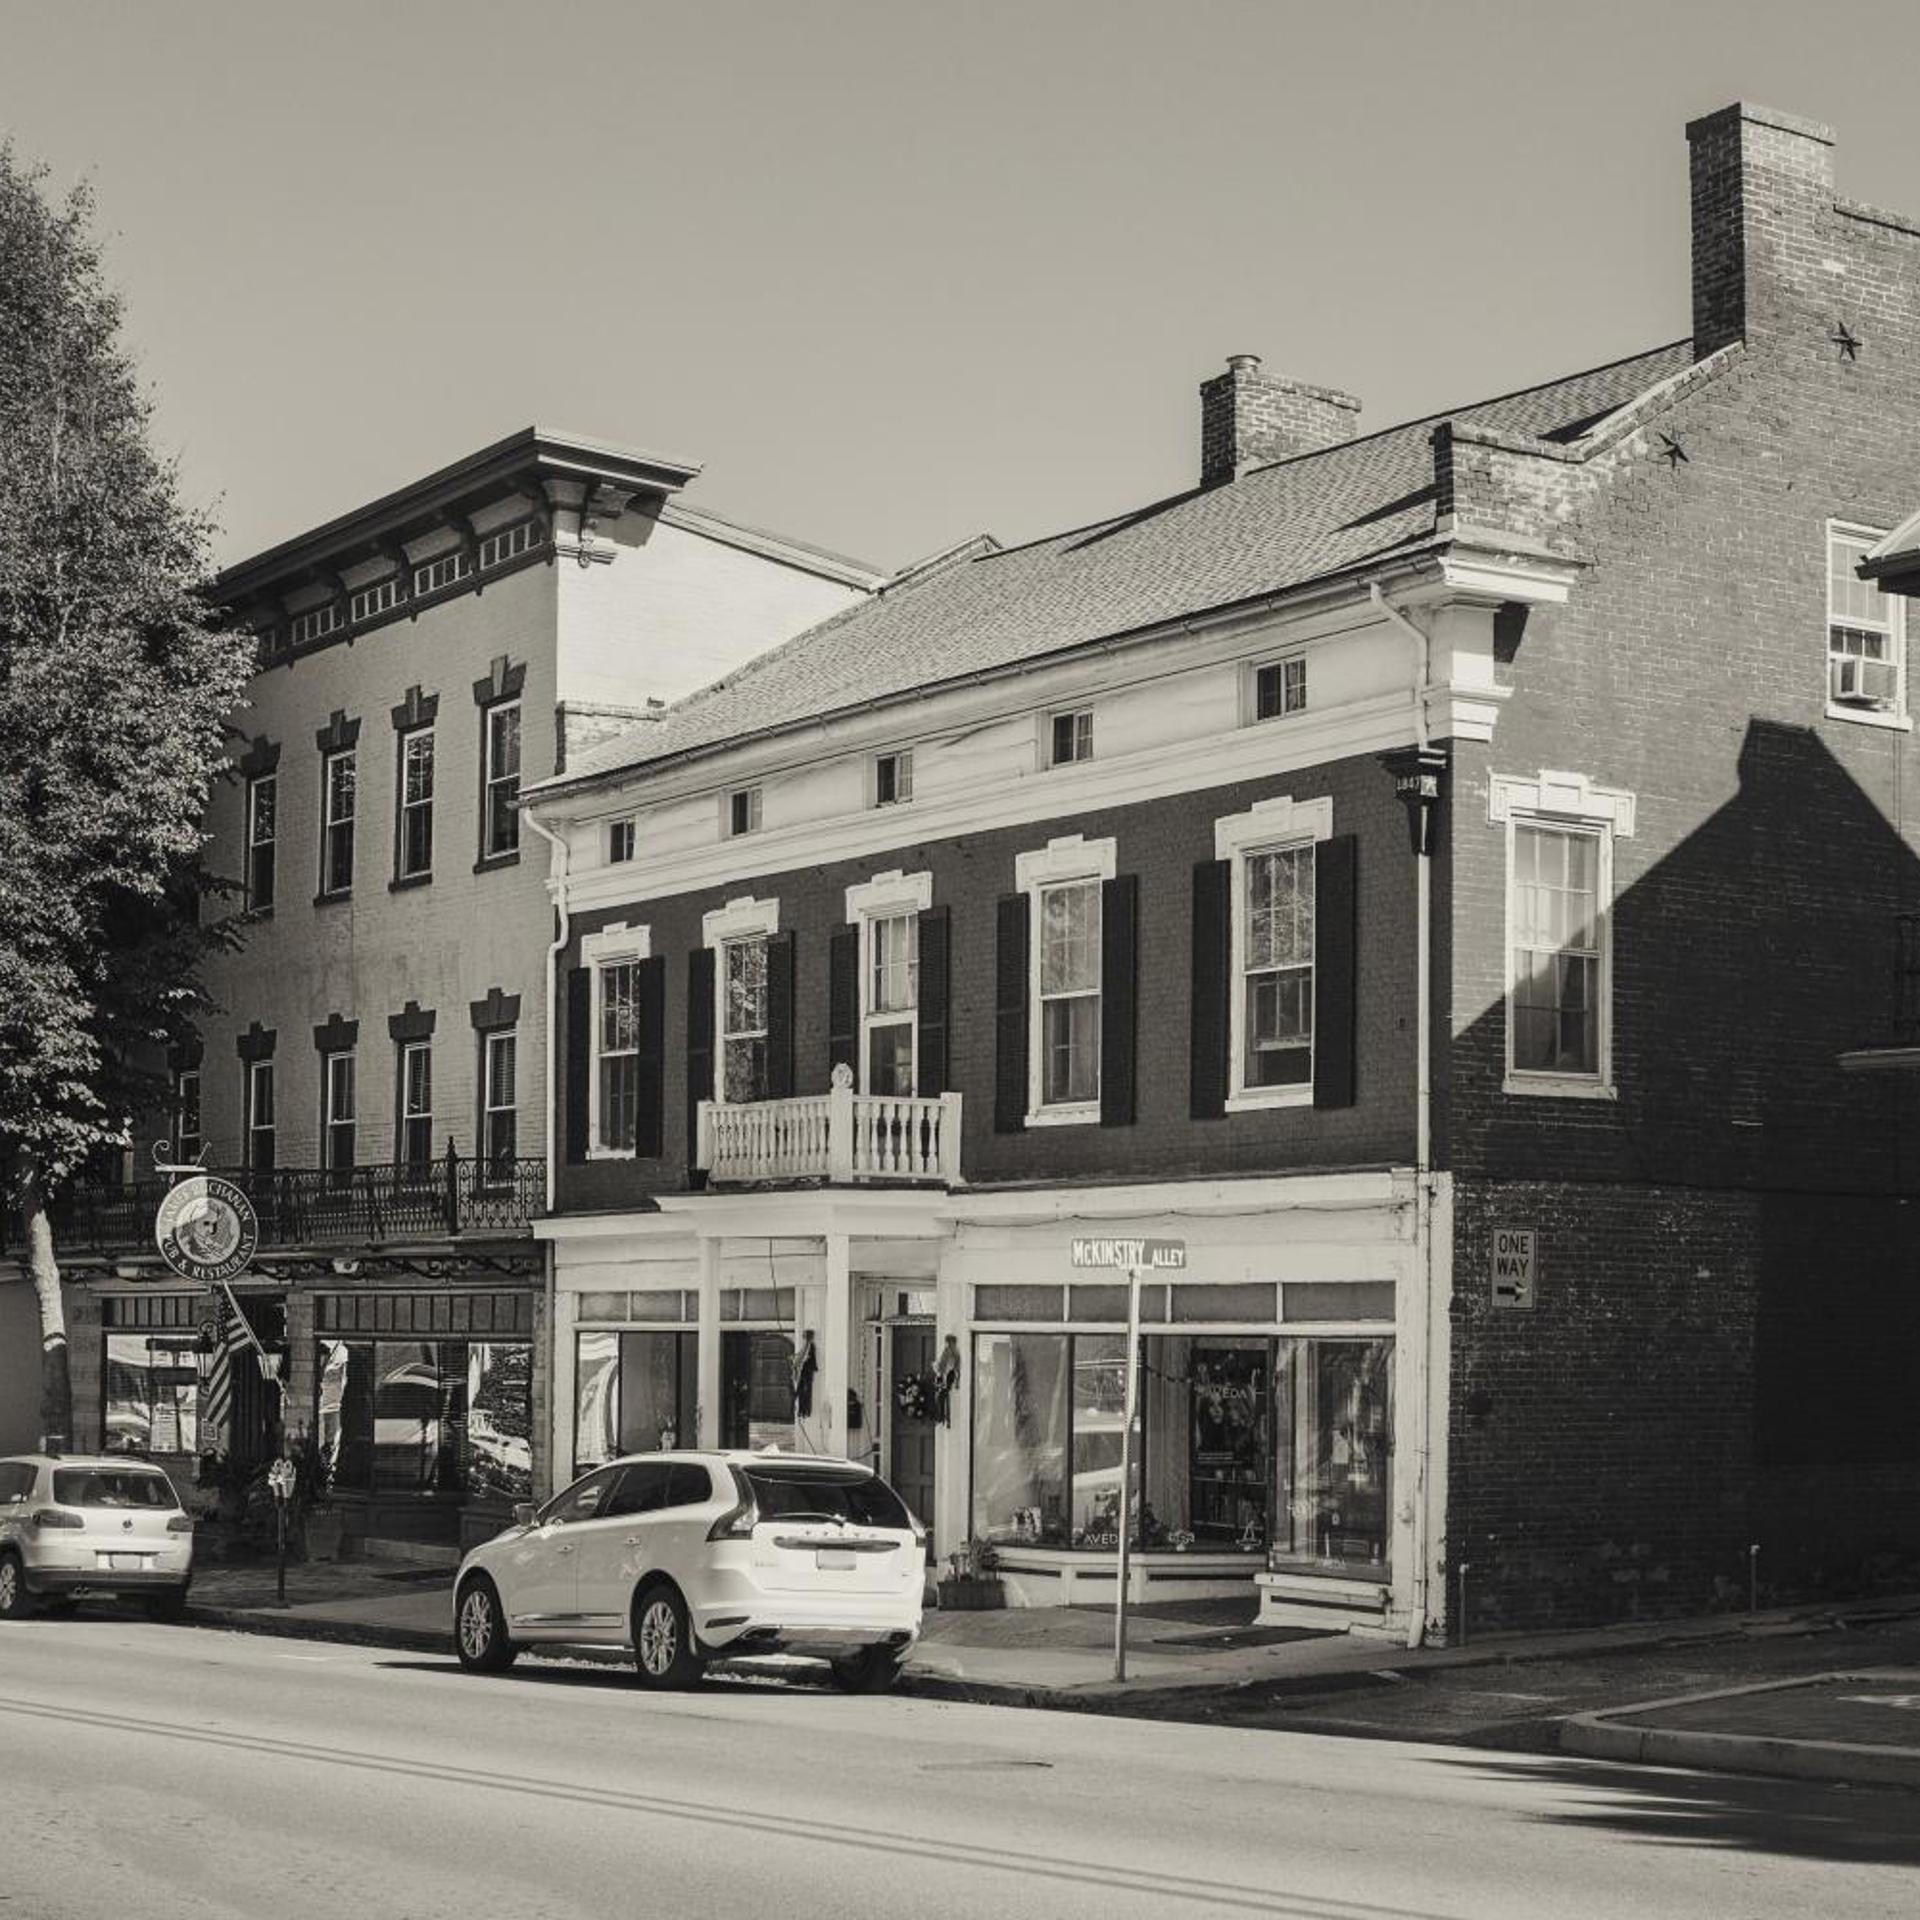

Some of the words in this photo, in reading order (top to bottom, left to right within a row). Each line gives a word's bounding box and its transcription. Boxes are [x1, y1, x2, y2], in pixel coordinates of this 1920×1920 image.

[1499, 1234, 1529, 1254] ONE
[161, 1232, 180, 1258] PUB
[178, 1259, 188, 1271] &
[192, 1231, 254, 1279] RESTAURANT
[1151, 1248, 1184, 1266] ALLEY
[1497, 1257, 1529, 1277] WAY
[1084, 1533, 1119, 1545] AVED
